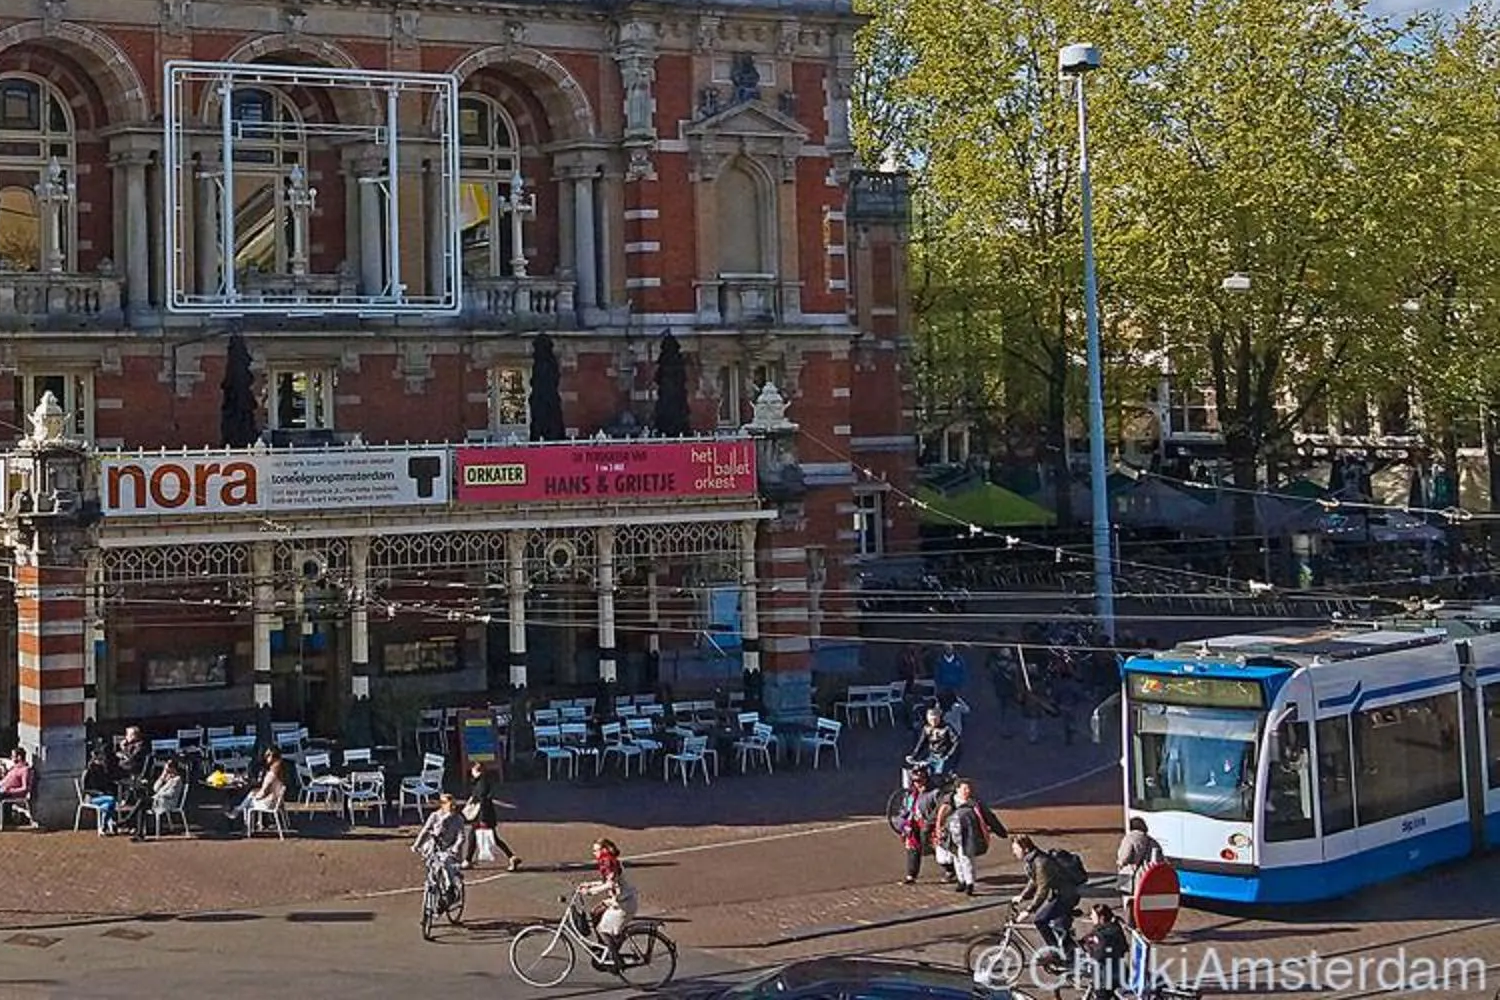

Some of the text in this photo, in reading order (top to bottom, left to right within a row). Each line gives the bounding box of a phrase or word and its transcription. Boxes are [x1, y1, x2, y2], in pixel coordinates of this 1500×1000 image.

[691, 446, 713, 463] het
[107, 462, 258, 509] nora
[467, 467, 524, 483] ORKATER
[545, 473, 676, 495] HANS & GRIETJE
[695, 466, 736, 489] orkest
